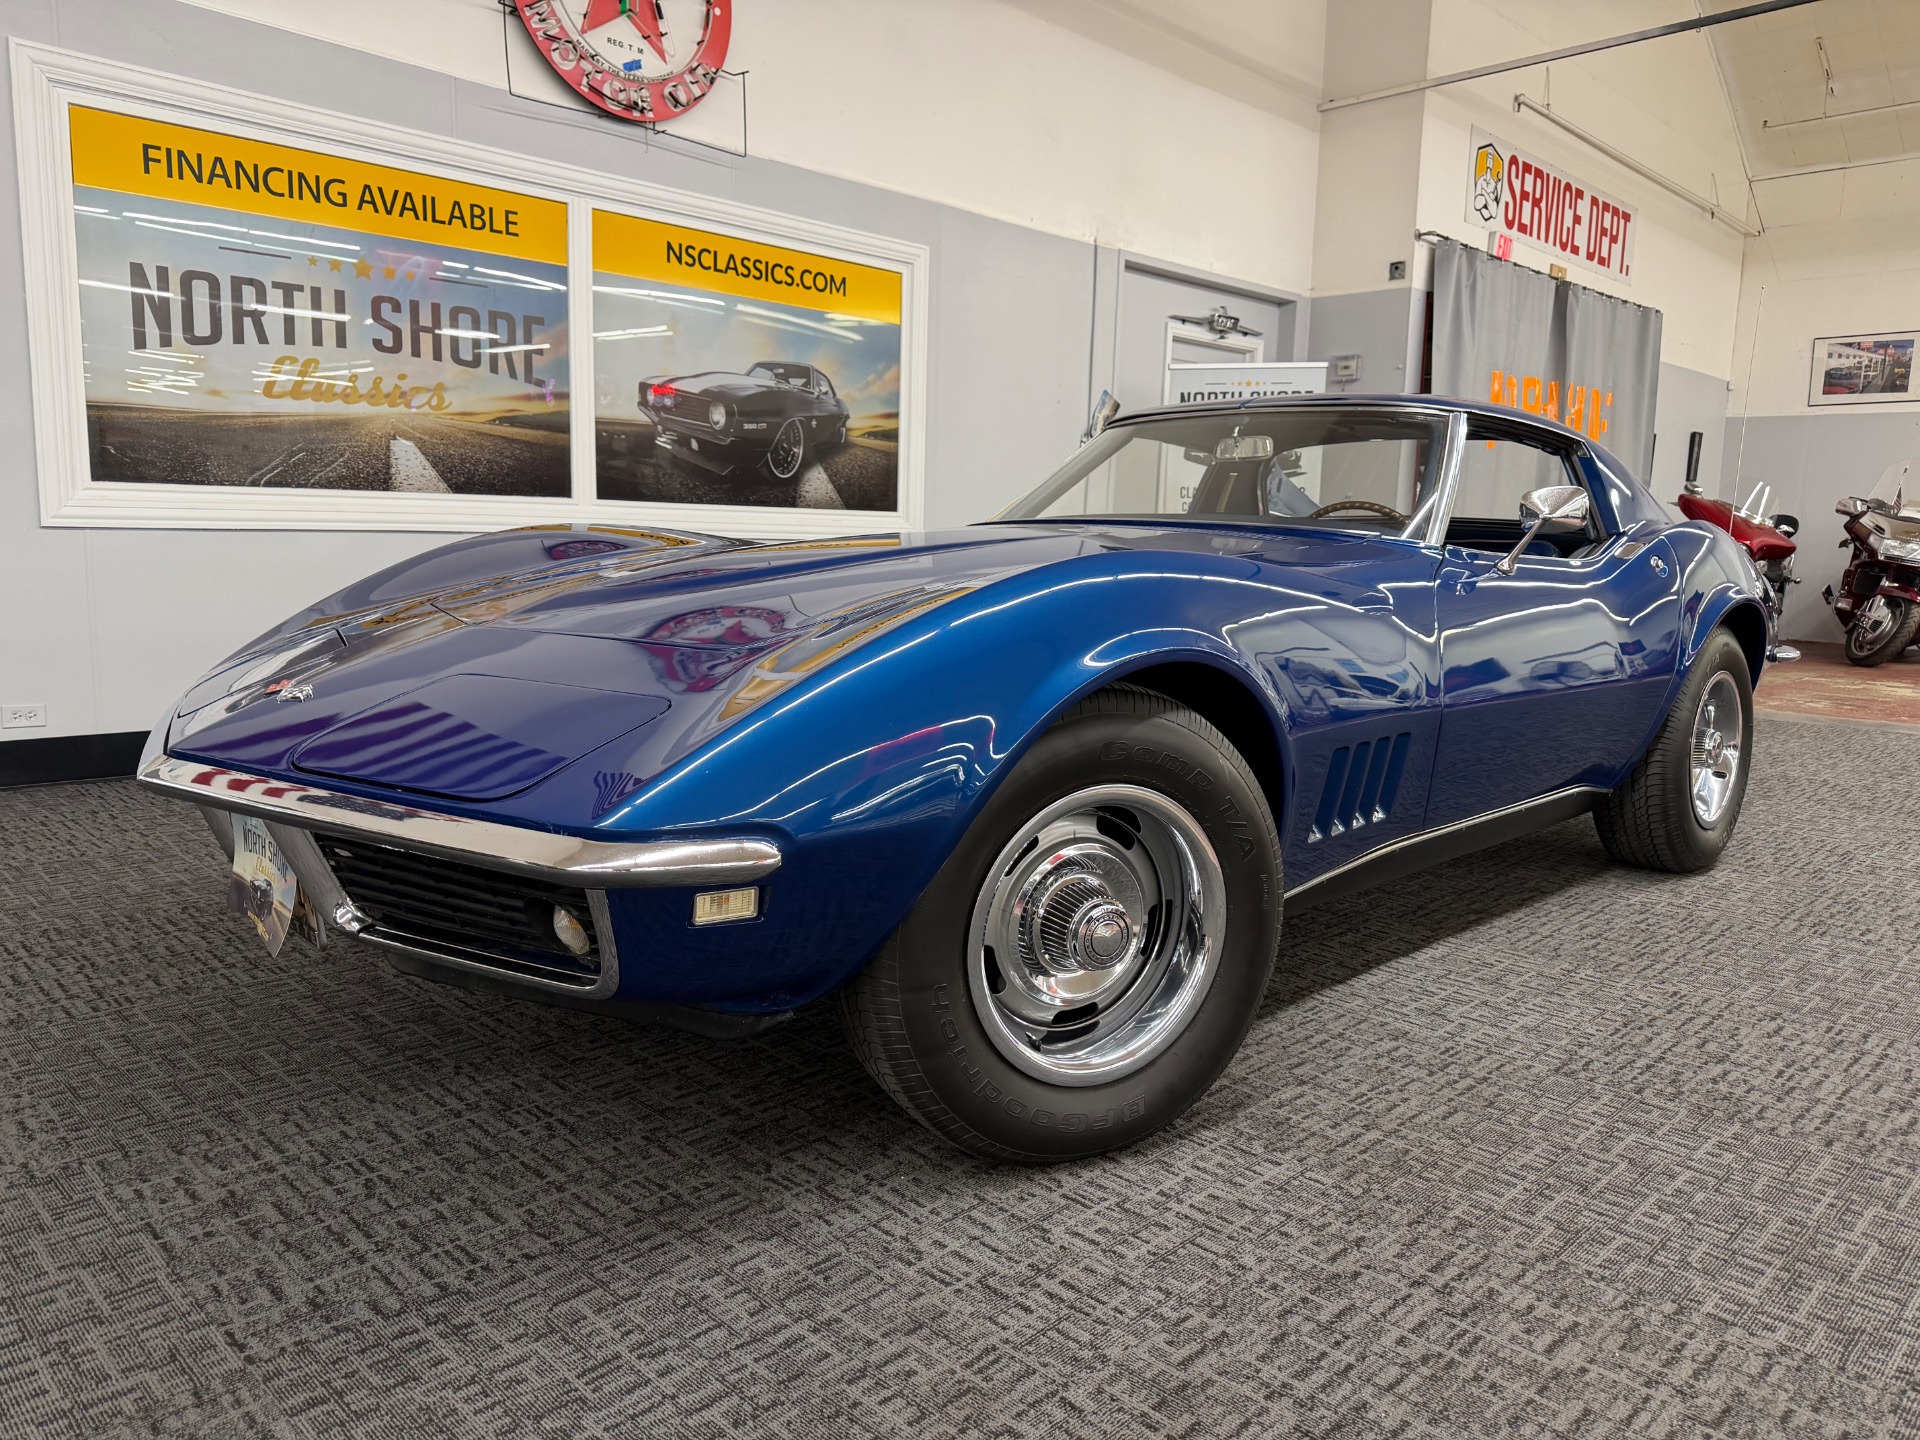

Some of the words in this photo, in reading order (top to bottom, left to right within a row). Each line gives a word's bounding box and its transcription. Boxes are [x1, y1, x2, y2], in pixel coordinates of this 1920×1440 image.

[606, 37, 626, 49] REG.
[142, 143, 348, 208] FINANCING
[357, 184, 520, 237] AVAILABLE
[1504, 154, 1585, 257] SERVICE
[1586, 192, 1632, 277] DEPT.
[666, 240, 847, 297] NSCLASSICS.COM
[128, 261, 352, 351] NORTH
[370, 294, 551, 389] SHORE
[261, 355, 453, 413] Classics
[242, 822, 267, 858] NORTH
[1098, 740, 1215, 790] Comp
[1218, 794, 1257, 864] T/A
[930, 982, 1148, 1134] BFGoodrich
